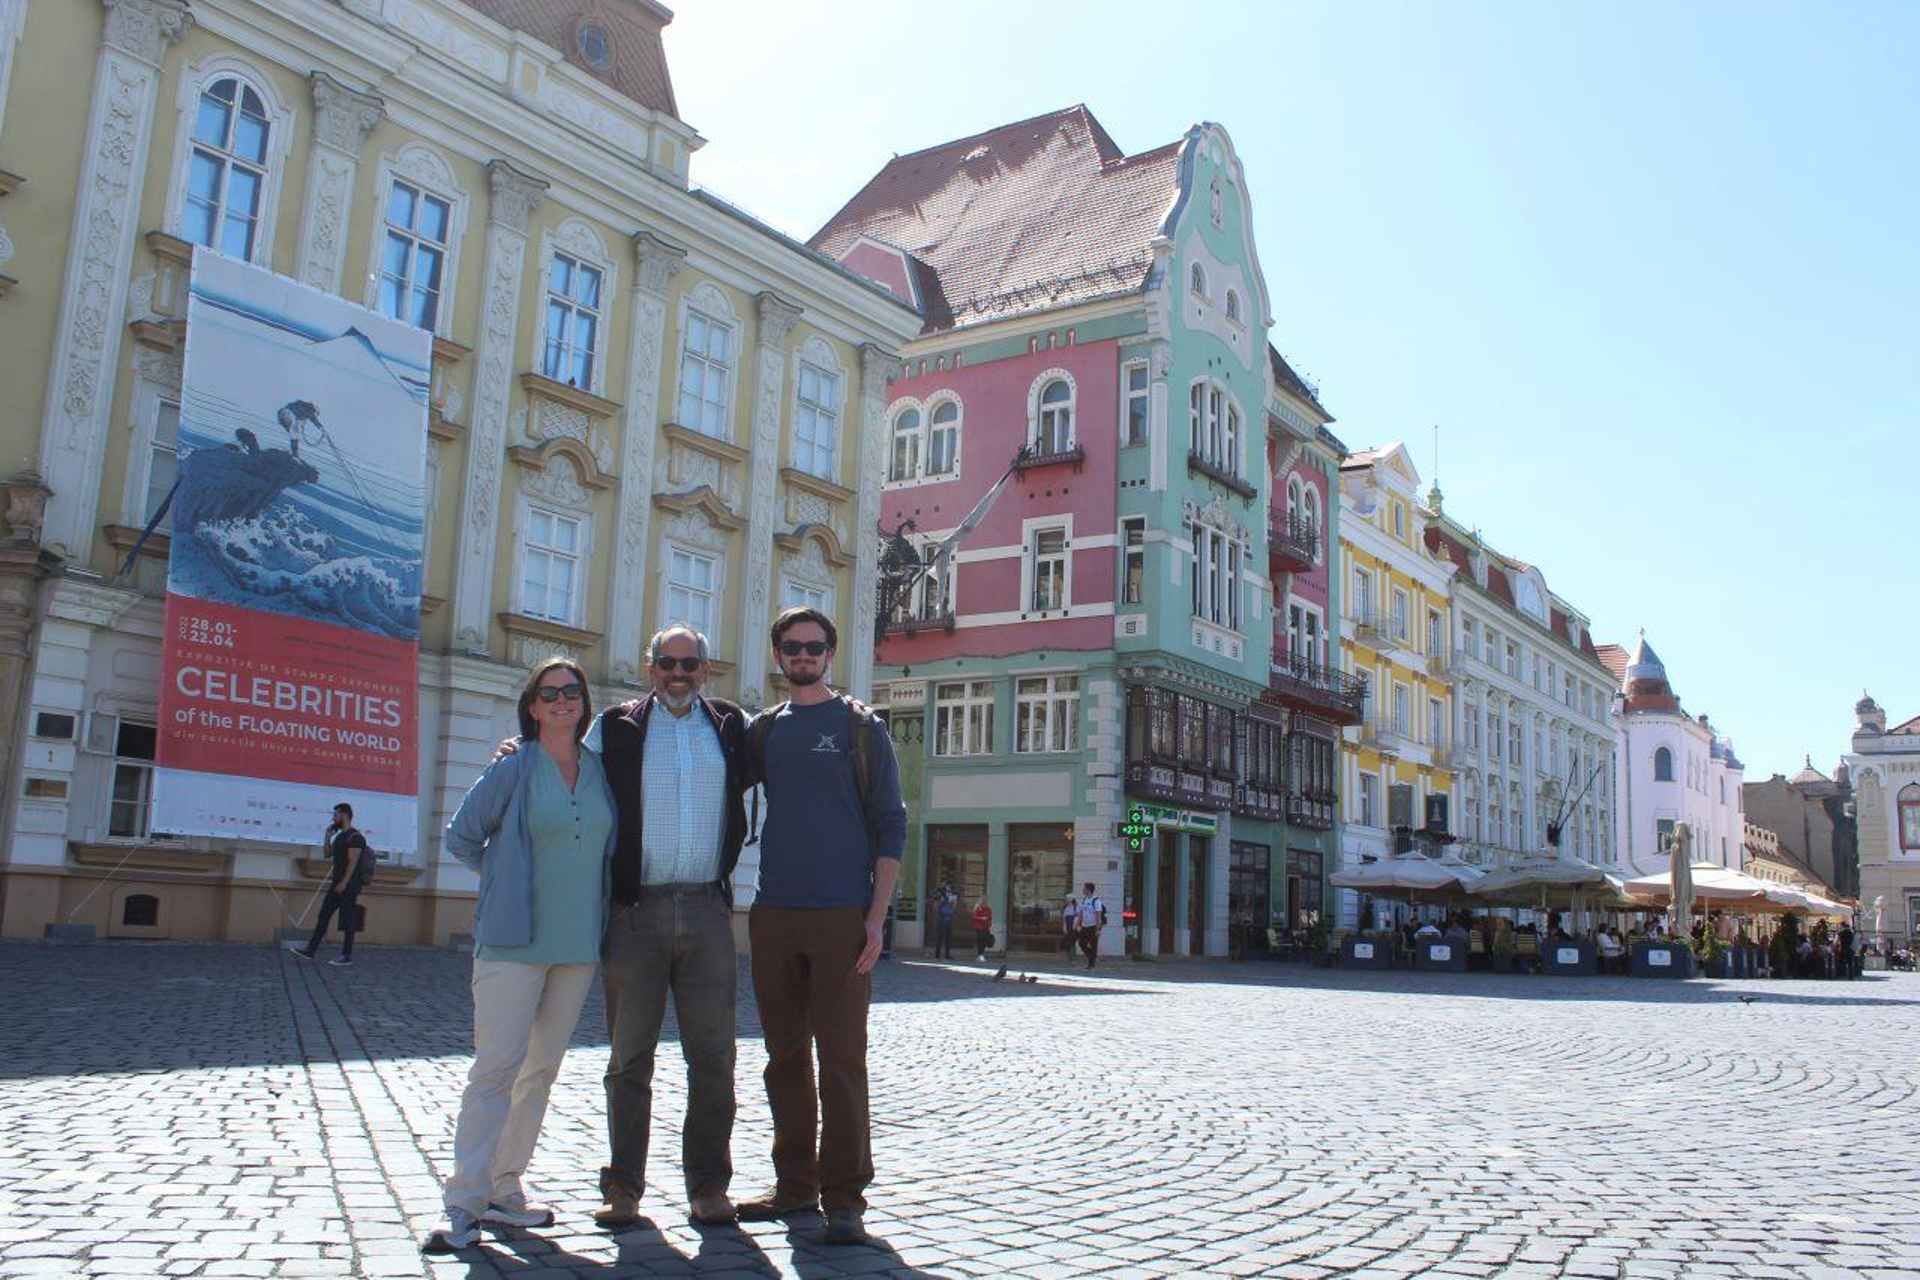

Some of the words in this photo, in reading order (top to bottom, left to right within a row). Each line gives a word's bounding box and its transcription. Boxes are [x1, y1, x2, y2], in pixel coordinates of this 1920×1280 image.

[190, 617, 238, 635] 28.01-
[190, 629, 235, 648] 22.04
[176, 666, 402, 728] CELEBRITIES
[175, 707, 197, 725] of
[199, 709, 233, 729] the
[239, 714, 331, 743] FLOATING
[336, 727, 401, 752] WORLD
